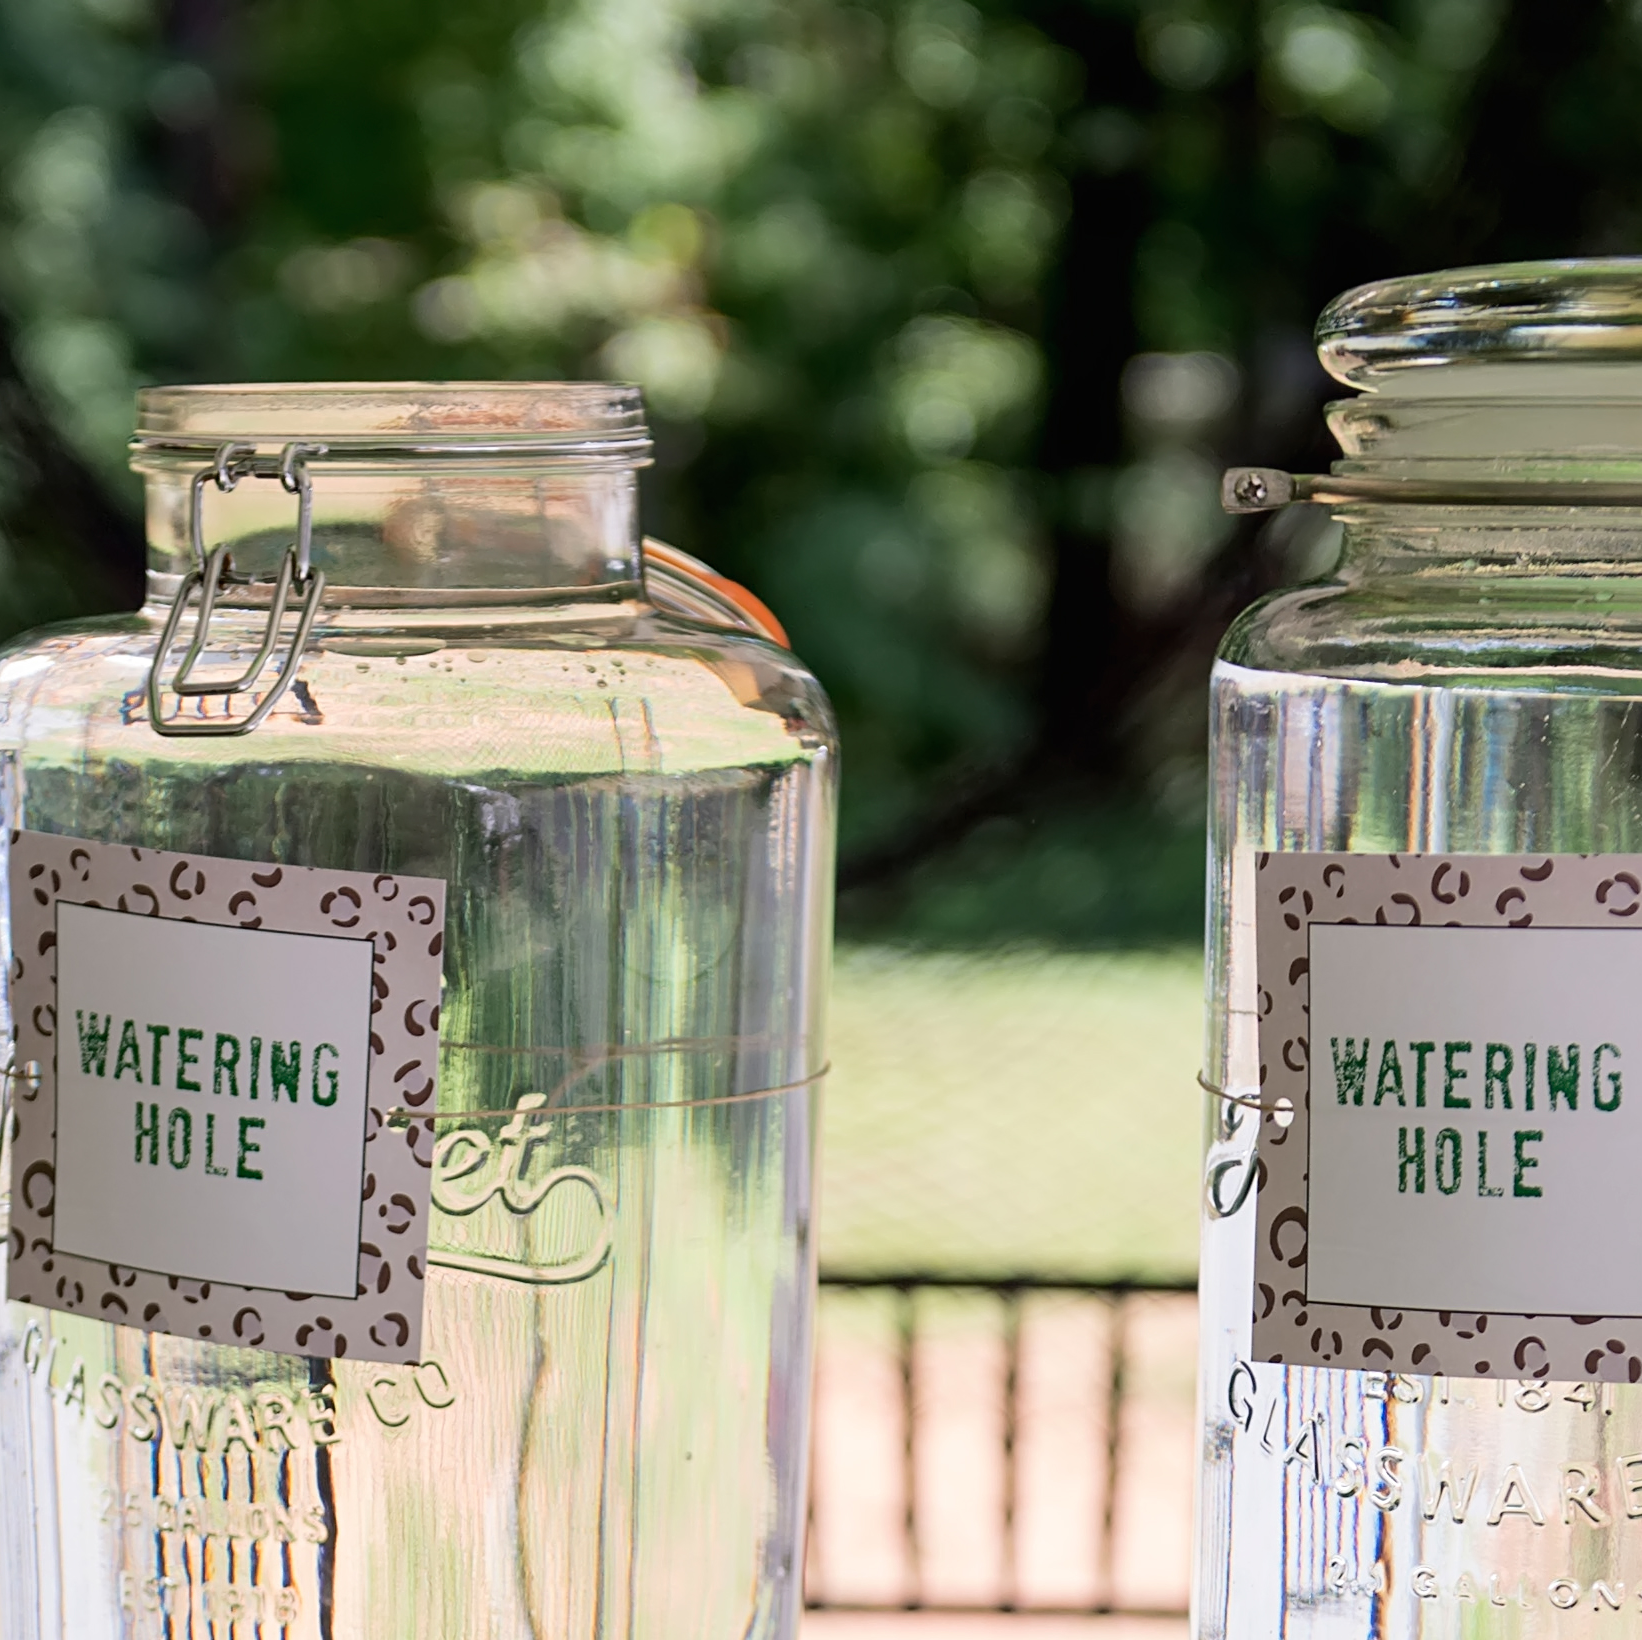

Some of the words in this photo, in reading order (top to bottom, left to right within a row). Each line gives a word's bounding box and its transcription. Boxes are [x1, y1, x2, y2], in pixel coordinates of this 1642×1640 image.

[74, 1009, 339, 1107] WATERING
[1330, 1036, 1623, 1112] WATERING
[134, 1101, 265, 1180] HOLE
[1398, 1126, 1544, 1198] HOLE
[21, 1318, 343, 1454] GLASSWARE
[154, 1495, 331, 1544] GALLONS
